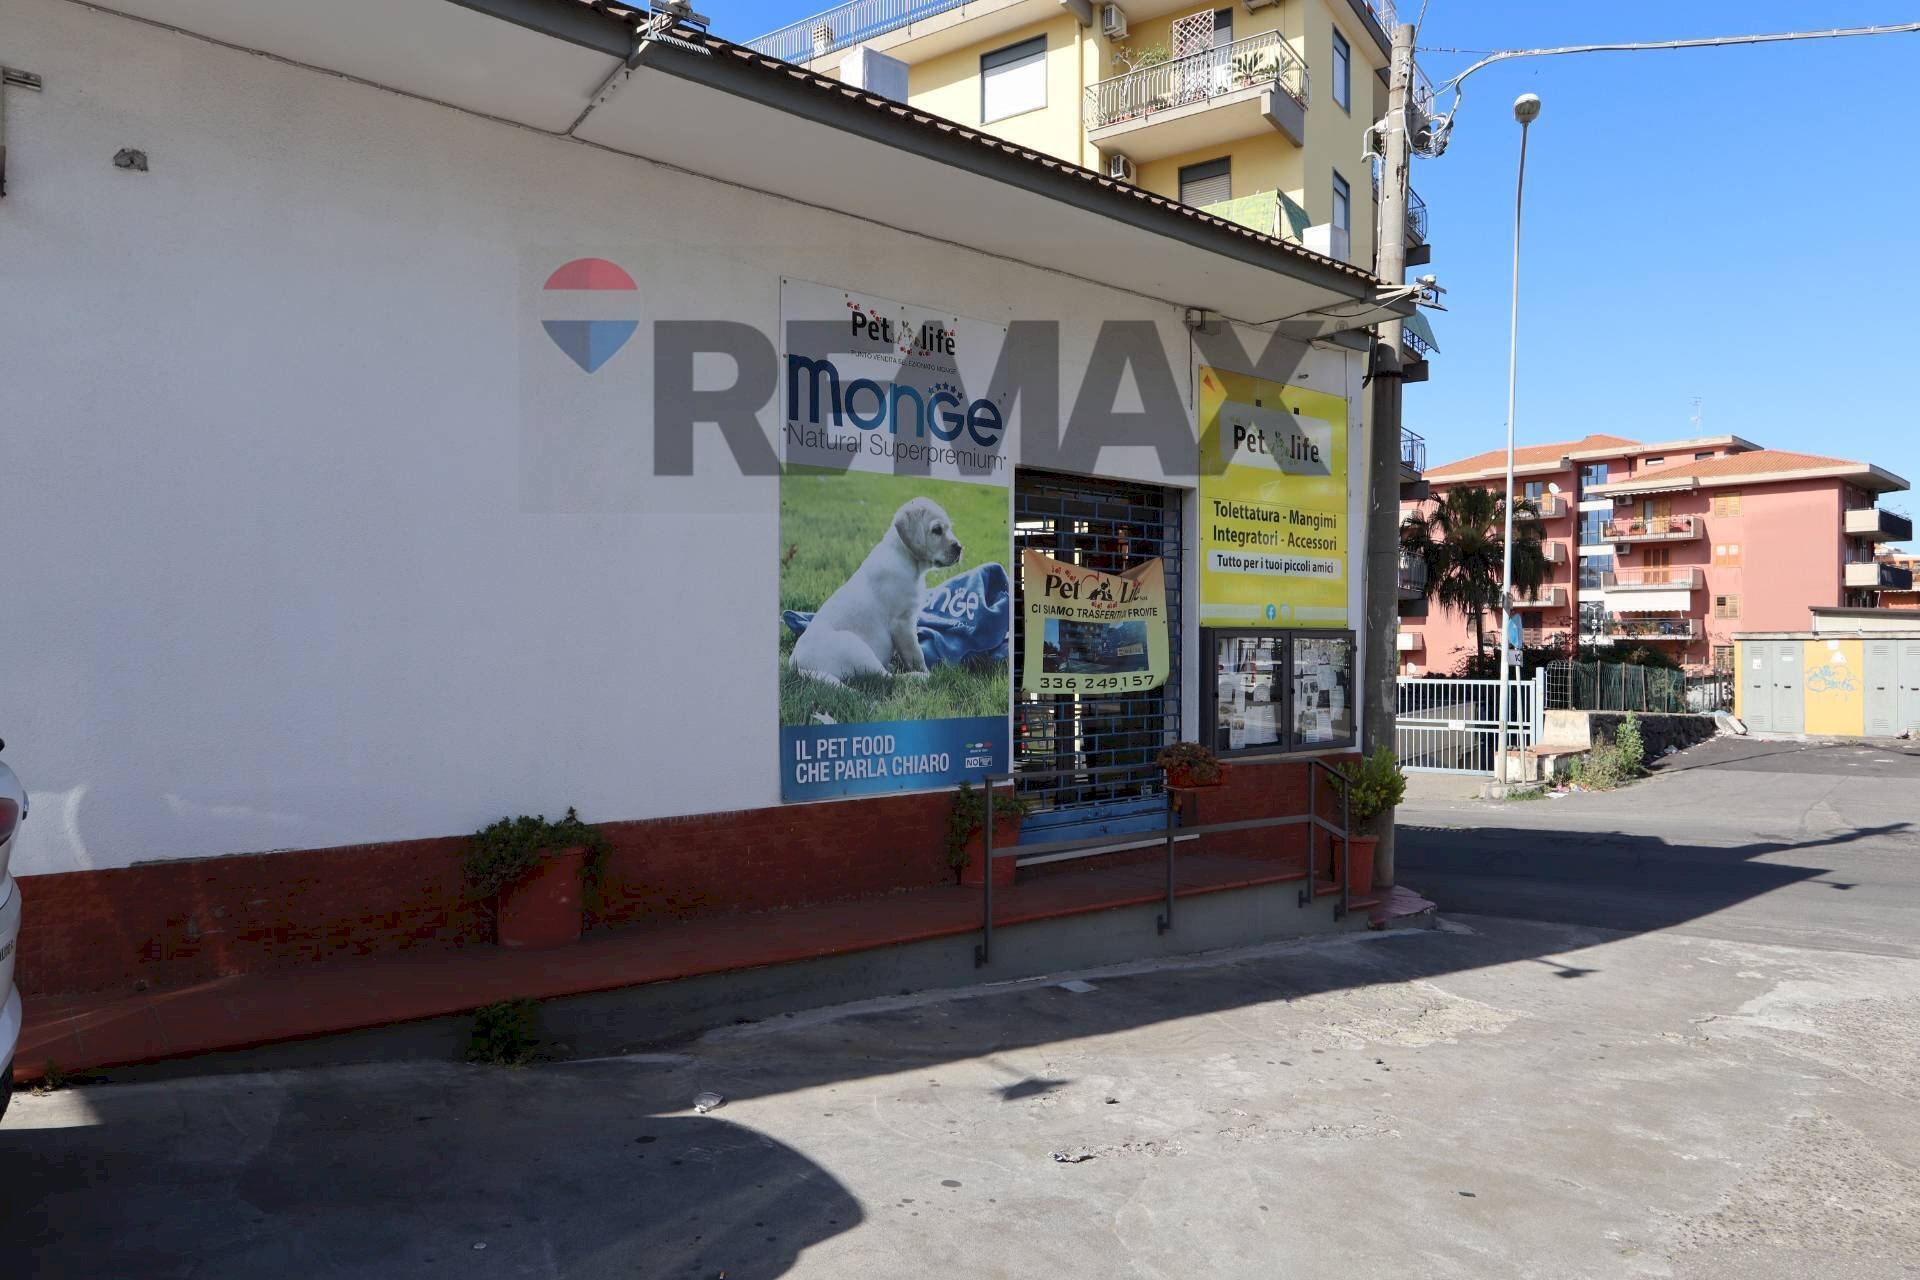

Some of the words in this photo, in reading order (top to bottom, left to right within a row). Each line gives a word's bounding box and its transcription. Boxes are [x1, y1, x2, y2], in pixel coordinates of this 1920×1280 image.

[852, 311, 890, 343] Pet
[921, 325, 955, 356] life
[787, 423, 862, 454] Natural
[870, 433, 1003, 471] Superpremium
[1233, 424, 1265, 454] Pet
[1290, 434, 1319, 463] life
[1213, 501, 1280, 523] Tolettatura
[1289, 509, 1337, 531] Mangimi
[1213, 525, 1278, 547] Integratori
[1287, 532, 1337, 551] Accessori
[1217, 554, 1242, 568] Tutto
[1243, 559, 1258, 571] per
[1265, 558, 1283, 571] tuoi
[1284, 559, 1311, 573] piccoli
[1312, 561, 1334, 574] amici
[1044, 574, 1080, 600] Pet
[1031, 603, 1041, 614] CI
[1043, 604, 1074, 616] SIAMO
[1040, 677, 1076, 689] 336
[1085, 675, 1154, 689] 249157
[795, 740, 812, 761] IL
[816, 737, 848, 759] PET
[852, 734, 896, 757] FOOD
[795, 761, 830, 784] CHE
[834, 757, 888, 781] PARLA
[892, 752, 950, 776] CHIARO
